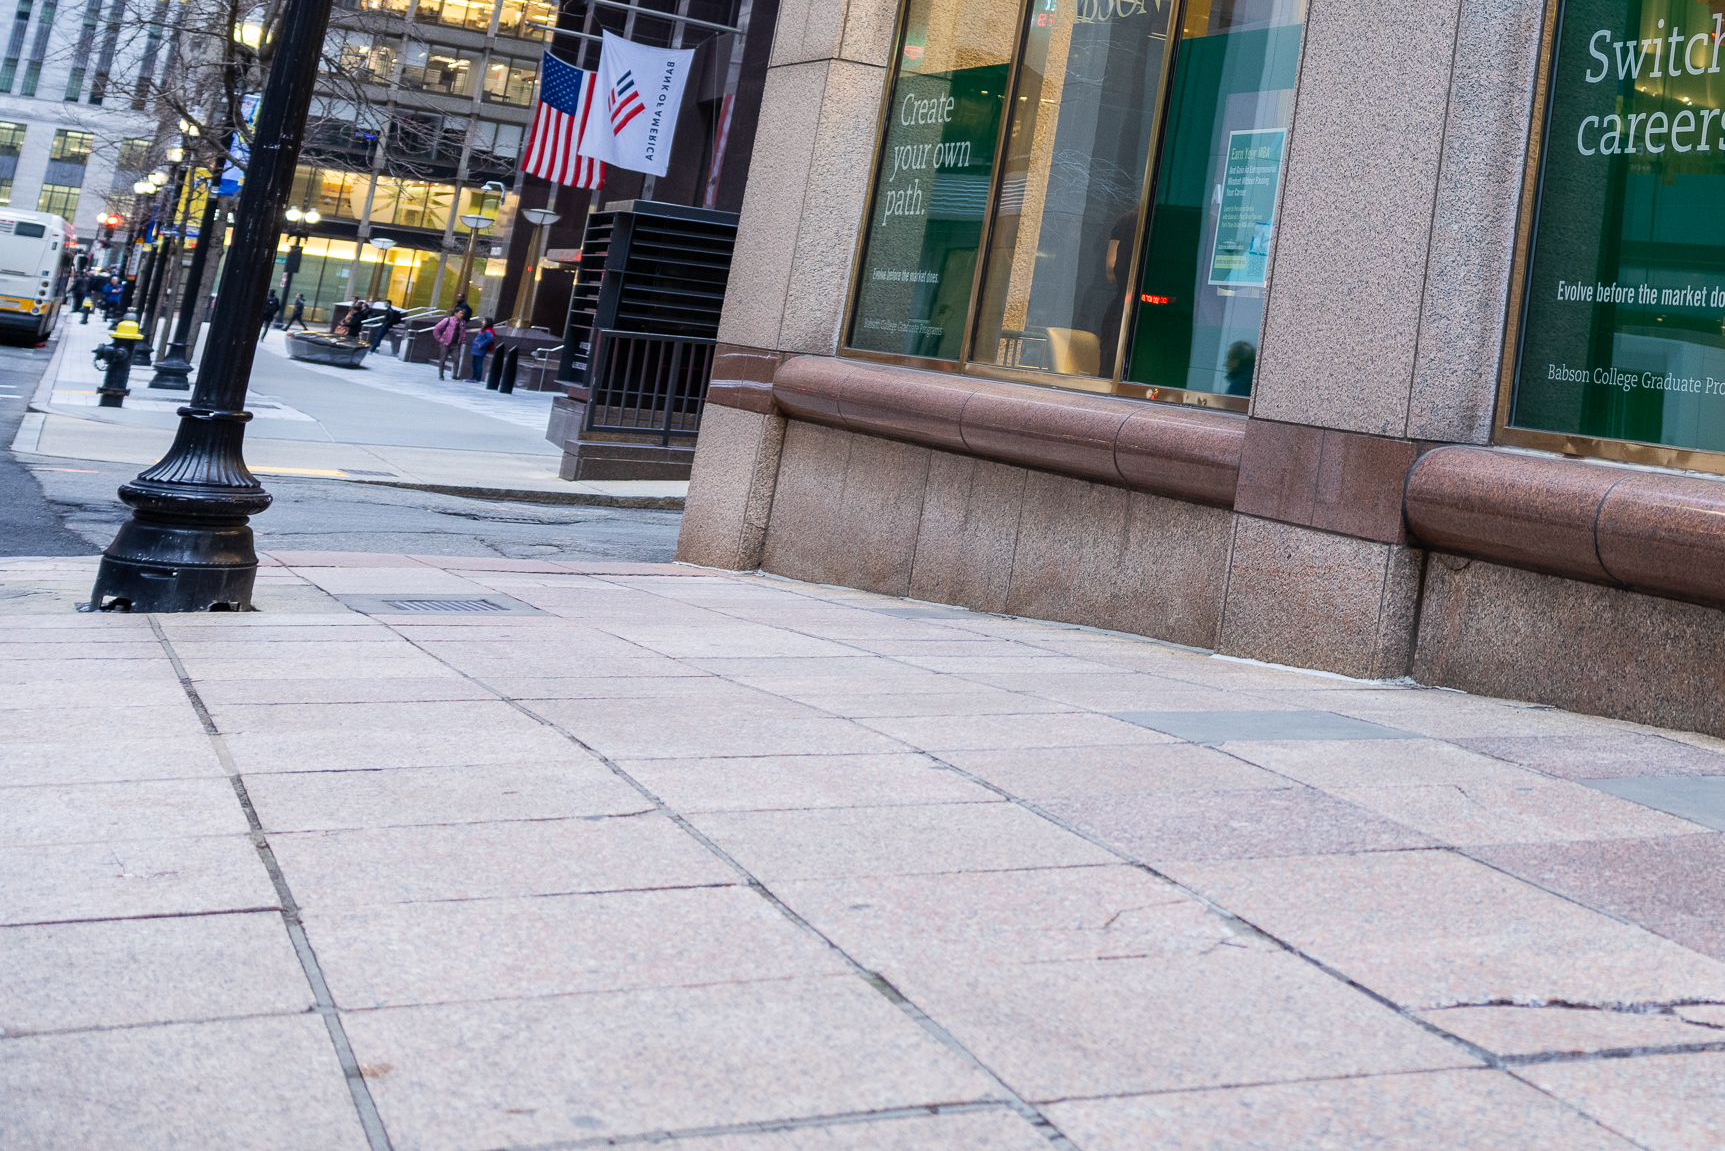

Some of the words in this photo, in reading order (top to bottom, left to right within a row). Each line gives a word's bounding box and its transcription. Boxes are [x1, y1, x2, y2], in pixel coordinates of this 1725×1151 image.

[901, 92, 955, 126] Create
[889, 143, 932, 182] your
[933, 140, 971, 169] own
[882, 179, 925, 226] path.
[1557, 280, 1594, 302] Evolve
[1596, 282, 1634, 303] before
[1638, 283, 1658, 305] the
[1661, 285, 1707, 307] market
[1547, 364, 1590, 383] Babson
[1593, 367, 1638, 391] College
[1642, 372, 1701, 394] Graduate
